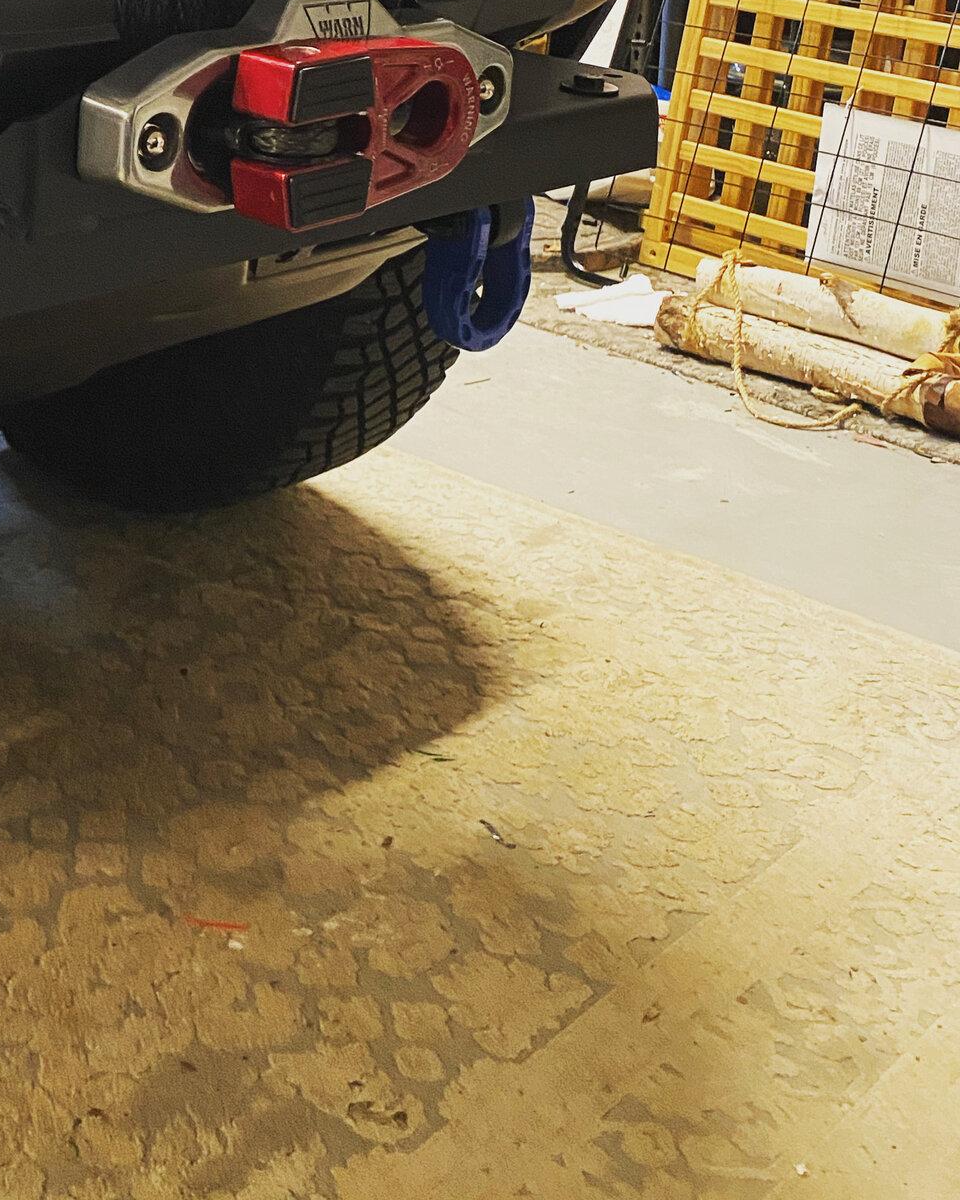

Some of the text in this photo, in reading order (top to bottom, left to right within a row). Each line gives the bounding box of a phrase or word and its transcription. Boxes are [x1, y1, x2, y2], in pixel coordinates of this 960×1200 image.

[318, 15, 365, 40] WARN
[916, 234, 923, 246] EN
[913, 247, 921, 268] MISE
